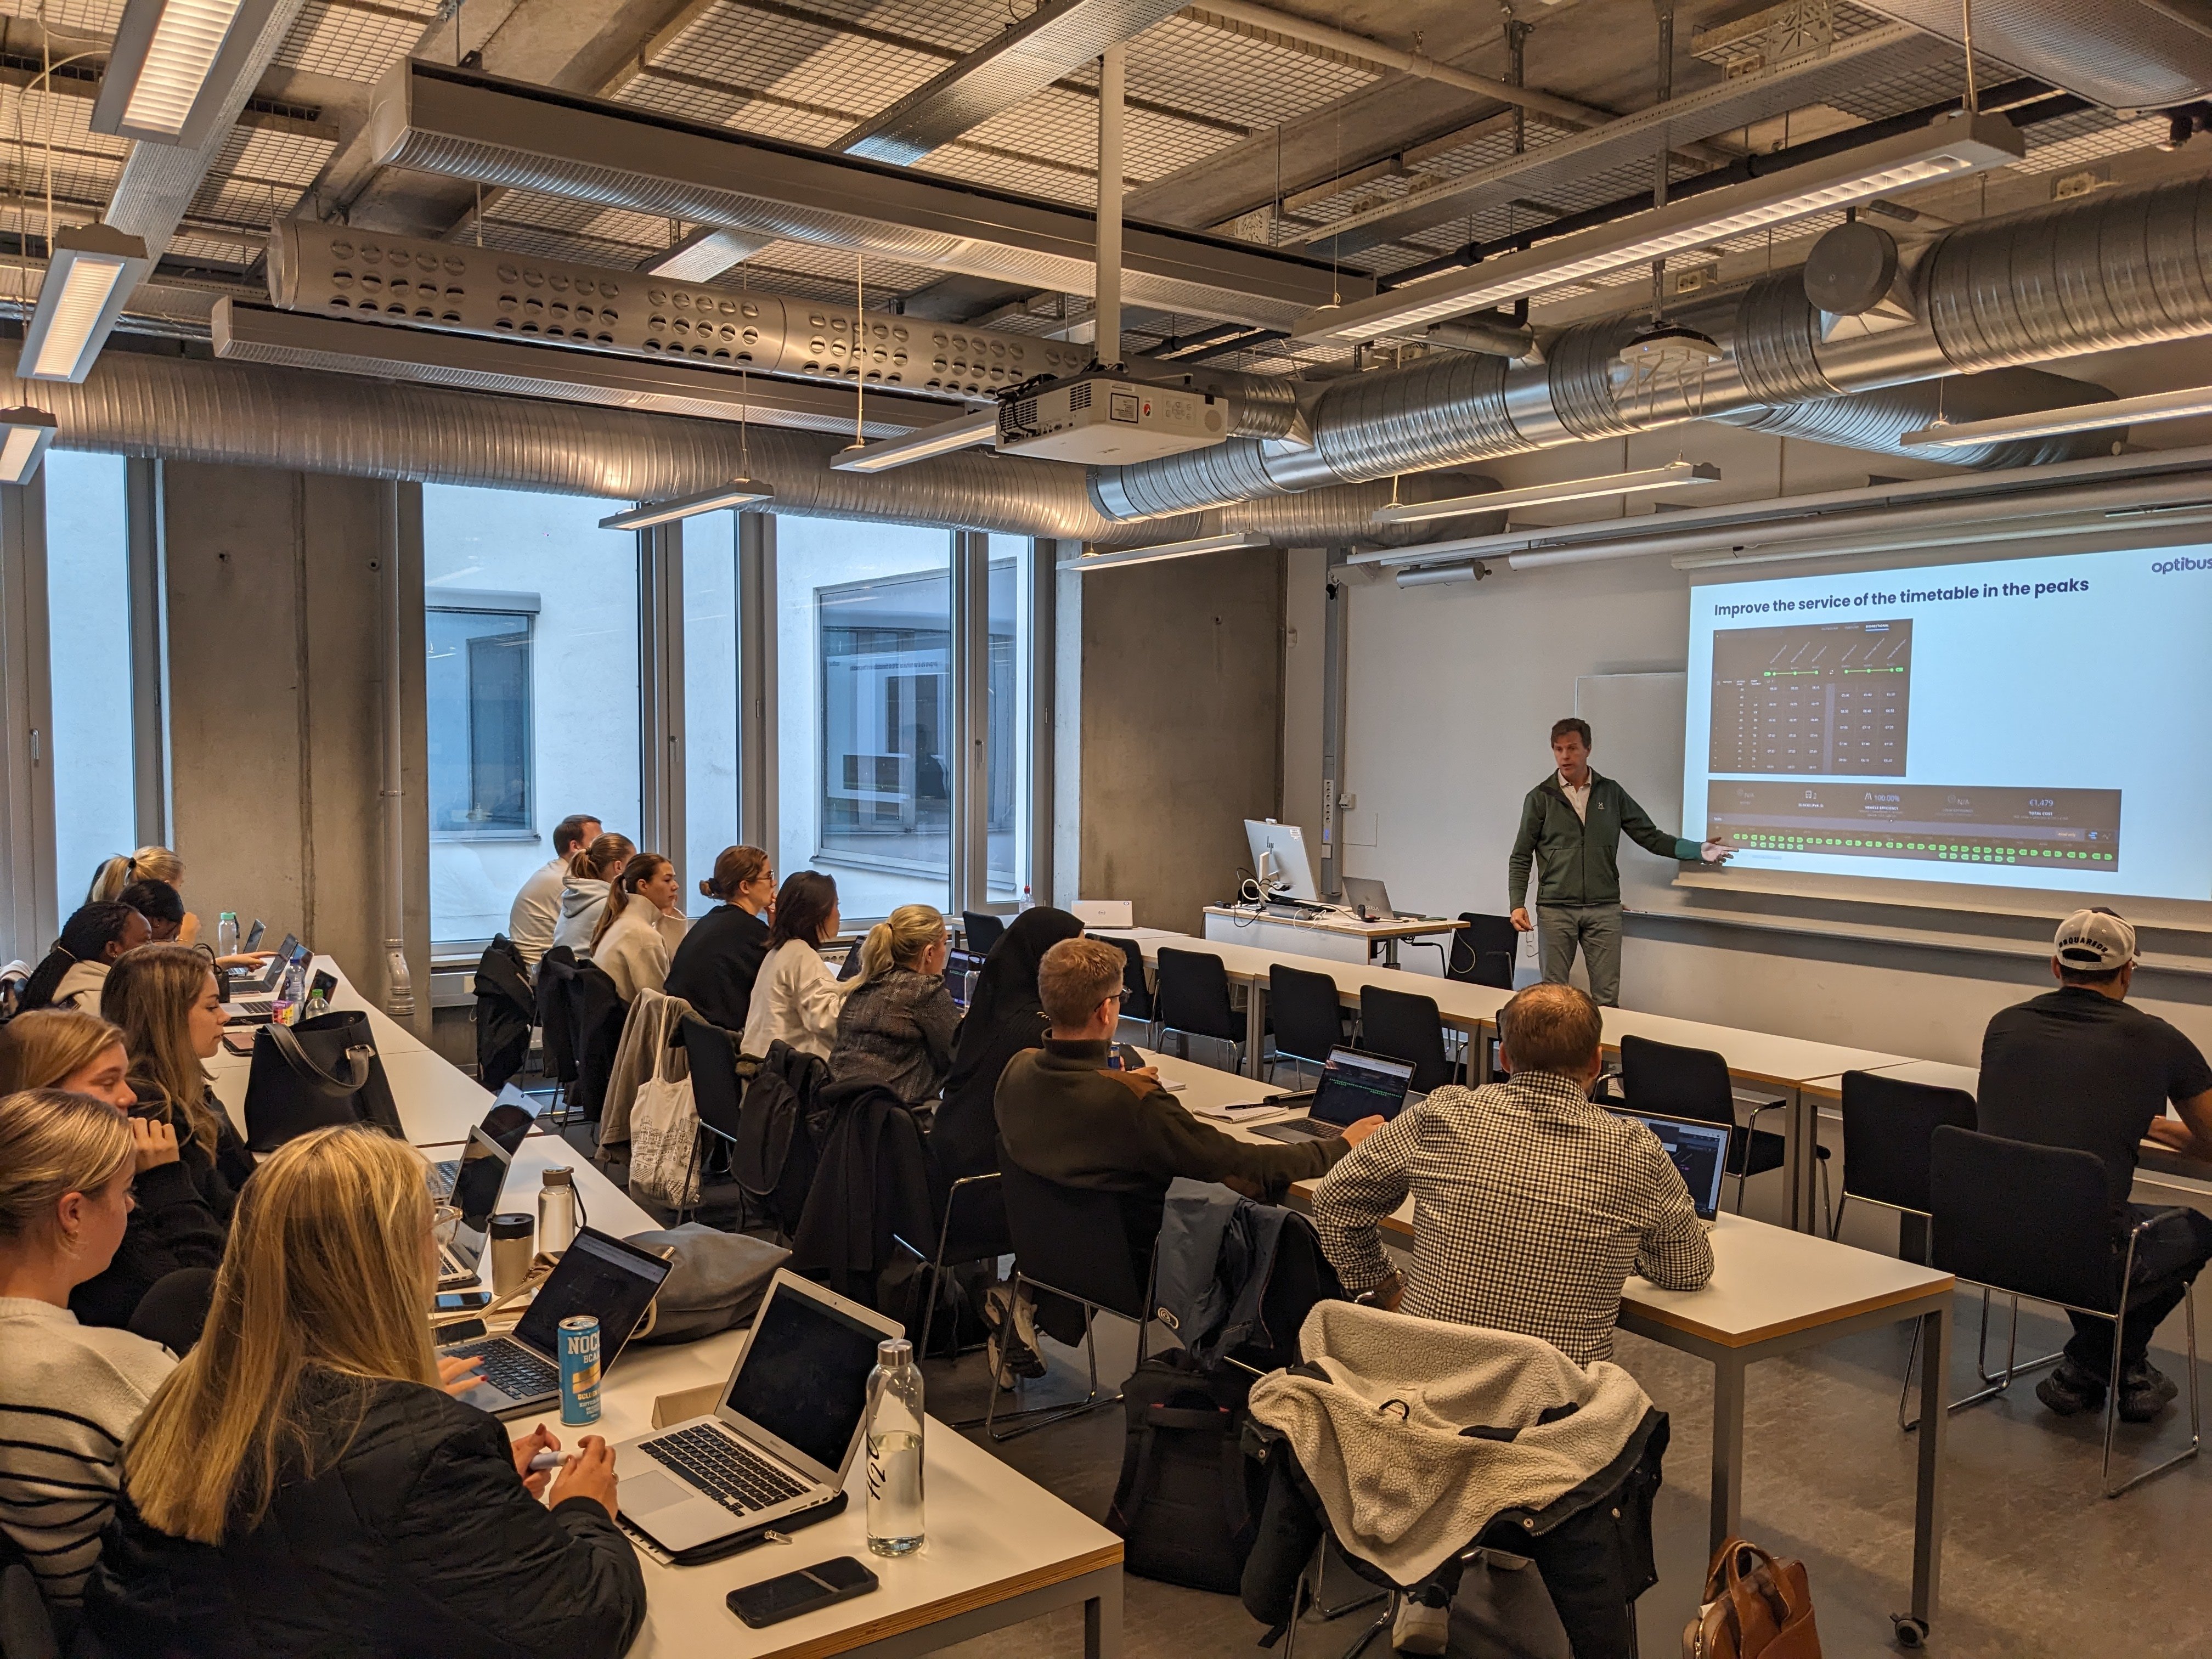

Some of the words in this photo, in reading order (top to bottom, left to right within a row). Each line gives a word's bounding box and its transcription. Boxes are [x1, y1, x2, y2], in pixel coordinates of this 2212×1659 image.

[2152, 557, 2212, 574] optibus
[1714, 603, 1770, 618] Improve
[1773, 599, 1795, 612] the
[1798, 595, 1850, 610] service
[1854, 592, 1869, 606] of
[1871, 592, 1897, 605] the
[1900, 585, 1979, 603] timetable
[1983, 583, 1998, 597] in
[2002, 582, 2031, 596] the
[2034, 578, 2089, 599] peaks
[866, 1432, 886, 1500] H2O
